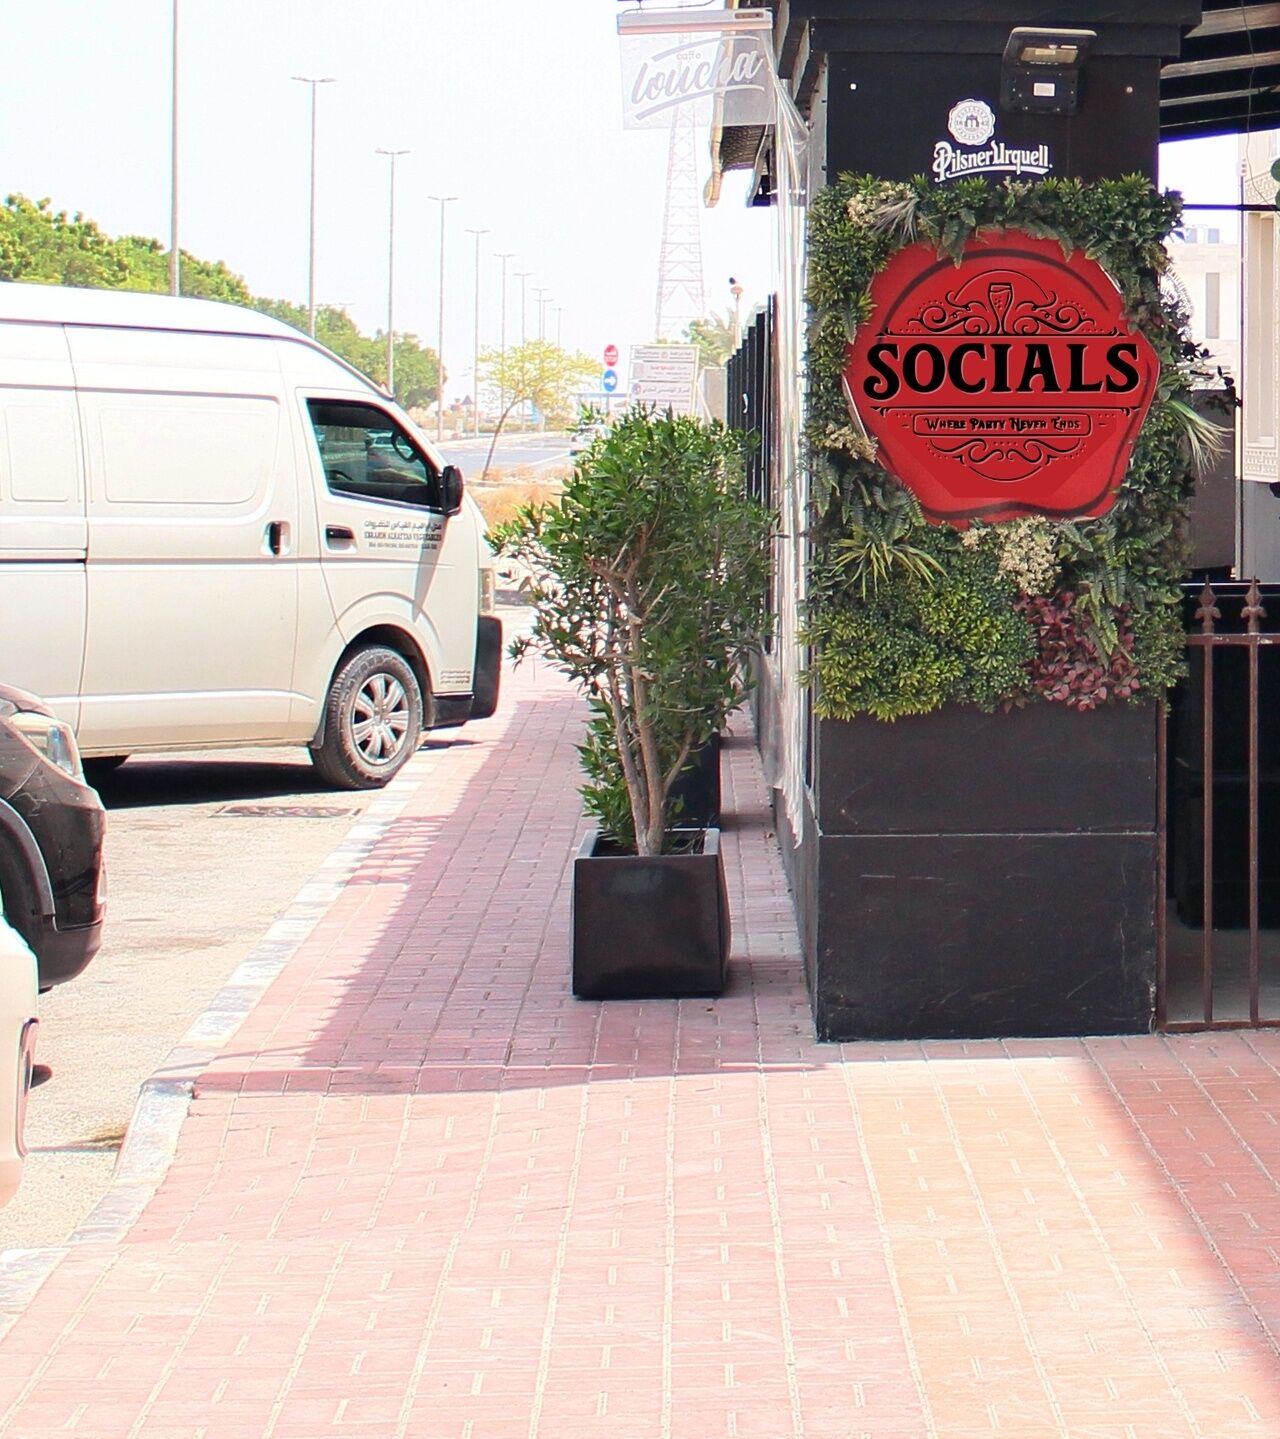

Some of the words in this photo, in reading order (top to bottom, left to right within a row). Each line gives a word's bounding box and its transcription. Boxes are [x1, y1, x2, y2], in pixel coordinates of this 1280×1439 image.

[932, 141, 993, 182] Pilsner
[991, 140, 1049, 175] Urquell
[863, 343, 1140, 400] SOCIALS
